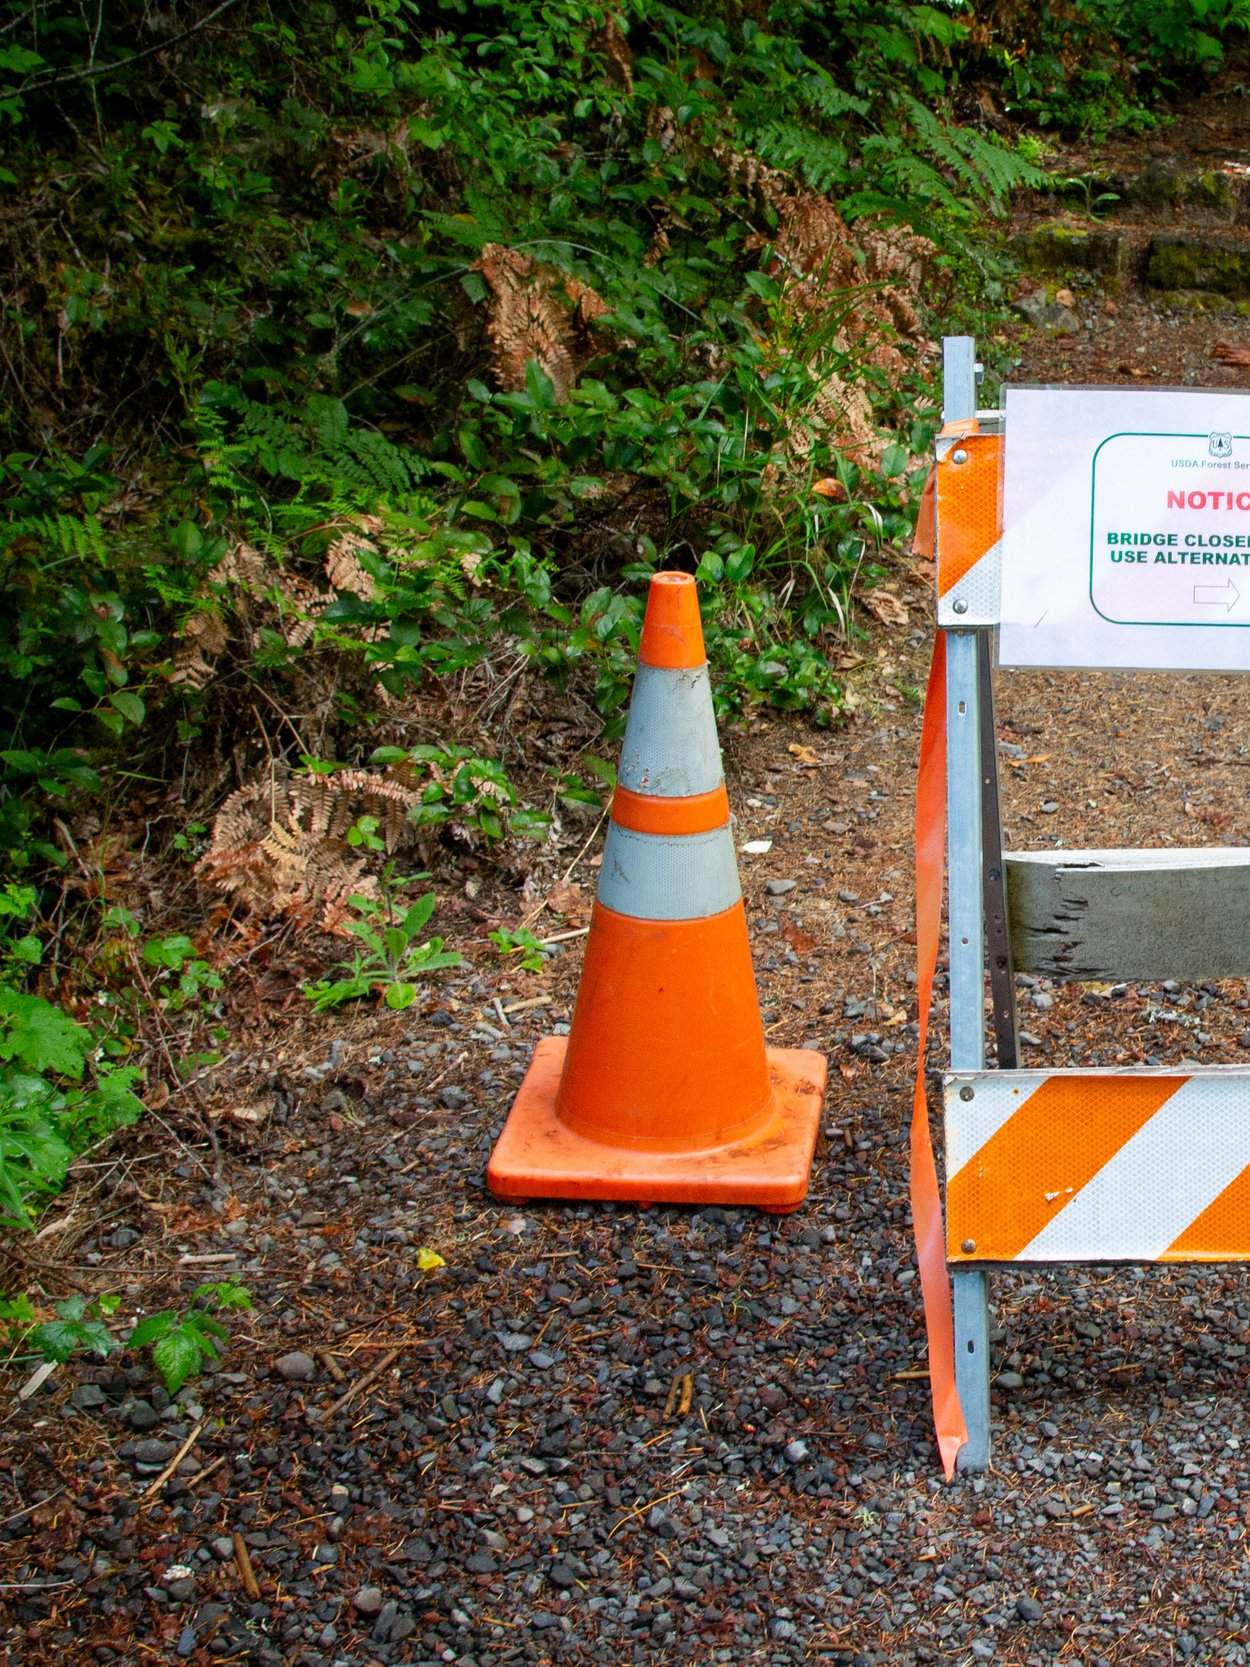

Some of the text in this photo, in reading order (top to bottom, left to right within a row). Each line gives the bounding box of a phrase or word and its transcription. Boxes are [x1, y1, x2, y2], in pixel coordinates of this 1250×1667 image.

[1171, 459, 1199, 468] USDA
[1201, 460, 1231, 469] Forest
[1107, 532, 1178, 546] BRIDGE
[1110, 550, 1147, 563] USE
